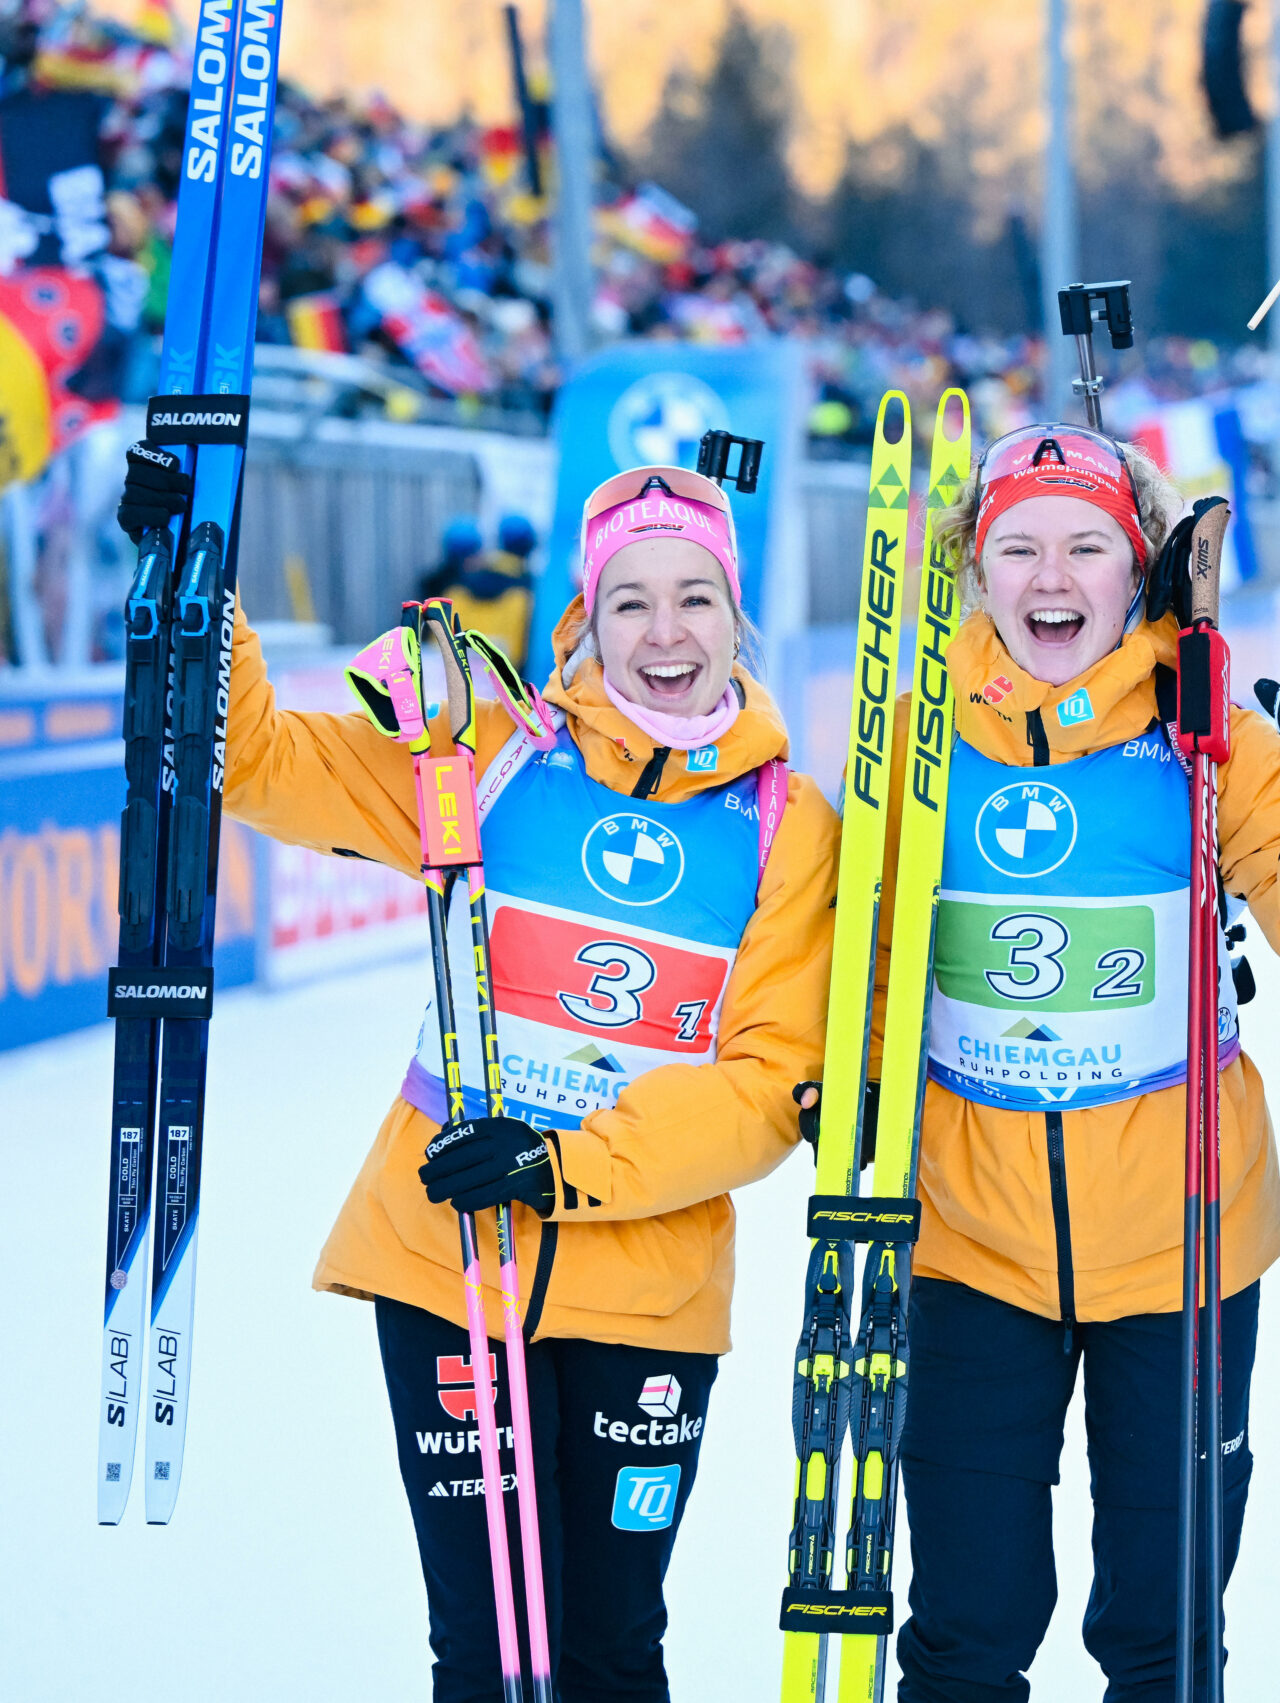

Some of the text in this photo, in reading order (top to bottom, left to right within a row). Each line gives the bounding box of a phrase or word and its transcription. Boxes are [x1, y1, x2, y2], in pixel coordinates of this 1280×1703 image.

[151, 412, 242, 427] SALOMON
[1012, 463, 1120, 495] Wärmepumpen
[595, 499, 718, 549] BIOTEAQUE
[853, 529, 899, 811] FISCHER
[212, 588, 236, 794] SALOMON
[434, 765, 462, 855] LEKI
[990, 786, 1067, 813] BMW
[602, 818, 675, 849] BMW
[982, 912, 1147, 1002] 3 2
[114, 984, 207, 1000] SALOMON
[557, 940, 707, 1041] 3 1
[957, 1034, 1123, 1068] CHIEMGAU
[959, 1057, 1124, 1080] RUHPOLDING
[122, 1131, 139, 1140] 187
[169, 1129, 188, 1138] 187
[121, 1157, 129, 1182] COLD
[169, 1155, 177, 1180] COLD
[812, 1210, 914, 1225] FISCHER
[593, 1410, 704, 1446] tectake
[628, 1475, 672, 1523] TQ
[786, 1603, 888, 1617] FISCHER
